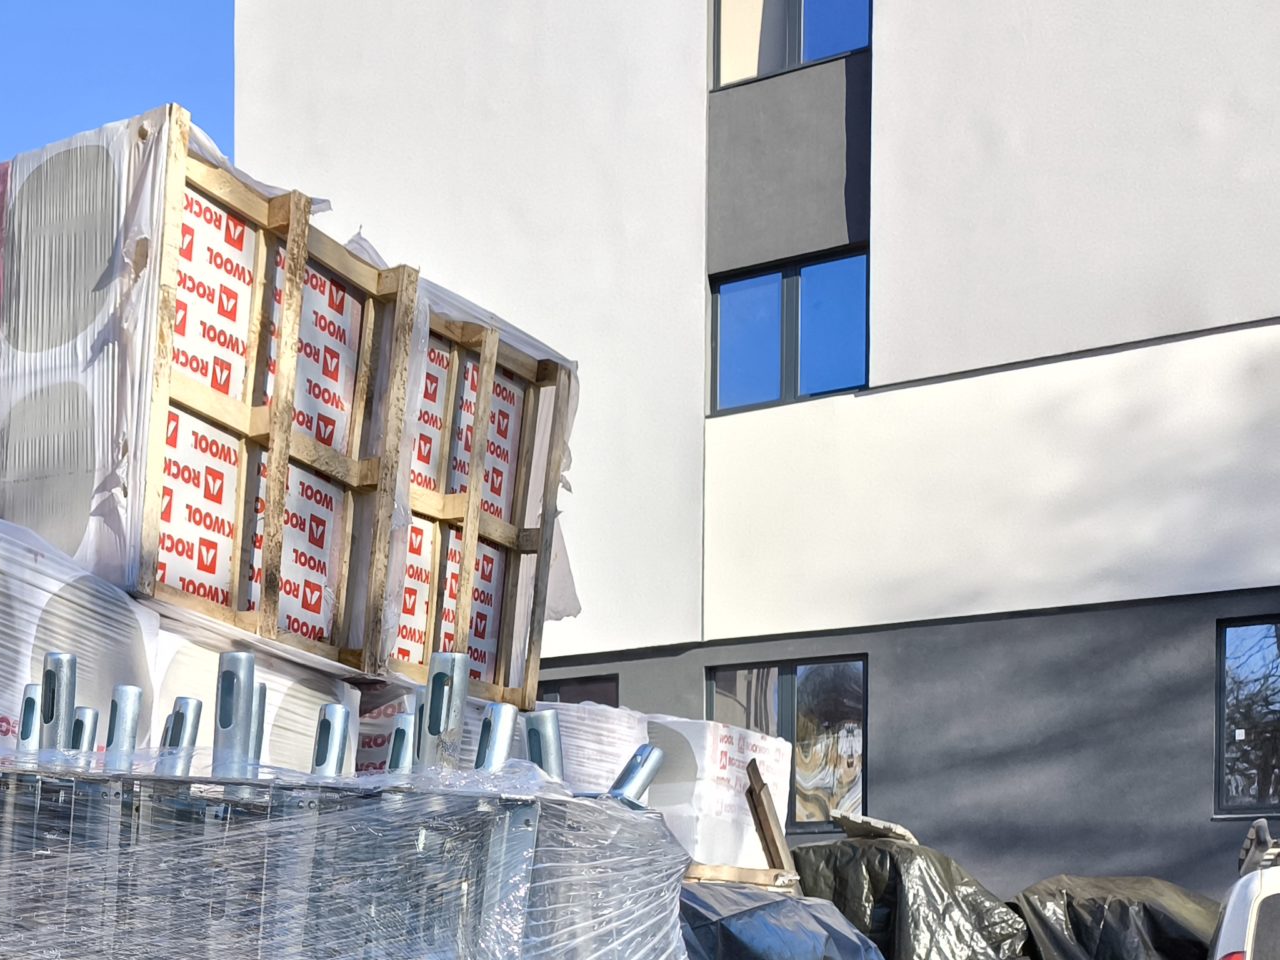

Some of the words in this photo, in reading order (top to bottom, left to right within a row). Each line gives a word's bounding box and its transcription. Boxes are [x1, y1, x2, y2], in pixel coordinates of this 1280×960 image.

[184, 193, 222, 230] ROCK
[177, 270, 215, 304] ROCK
[313, 310, 346, 345] WOOL
[299, 480, 334, 512] WOOL
[293, 548, 327, 577] WOOL
